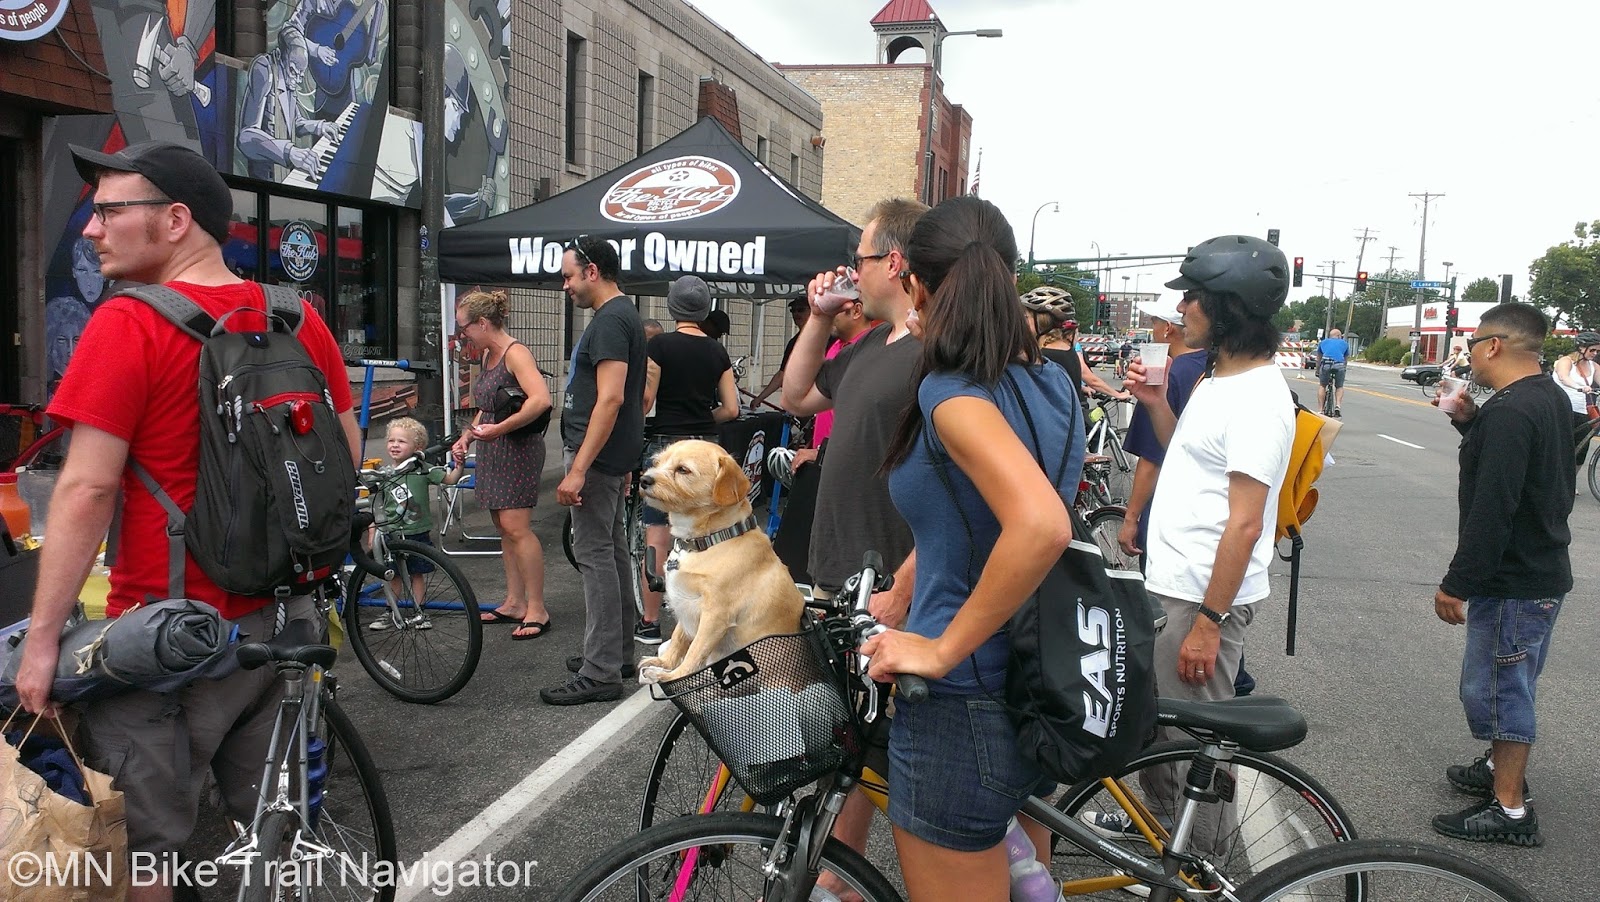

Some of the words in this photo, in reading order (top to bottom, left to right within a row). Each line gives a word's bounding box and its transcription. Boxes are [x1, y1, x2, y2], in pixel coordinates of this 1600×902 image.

[8, 12, 19, 26] of
[19, 3, 48, 29] people
[665, 160, 687, 171] types
[688, 159, 699, 167] of
[698, 160, 719, 172] bikes
[663, 185, 731, 203] Hub
[671, 208, 701, 220] people
[509, 236, 636, 275] Wor
[644, 232, 766, 275] Owned
[352, 346, 382, 356] GIANT
[1115, 607, 1126, 683] NUTRITION
[1077, 602, 1113, 739] EAS
[1109, 686, 1126, 738] SPORTS
